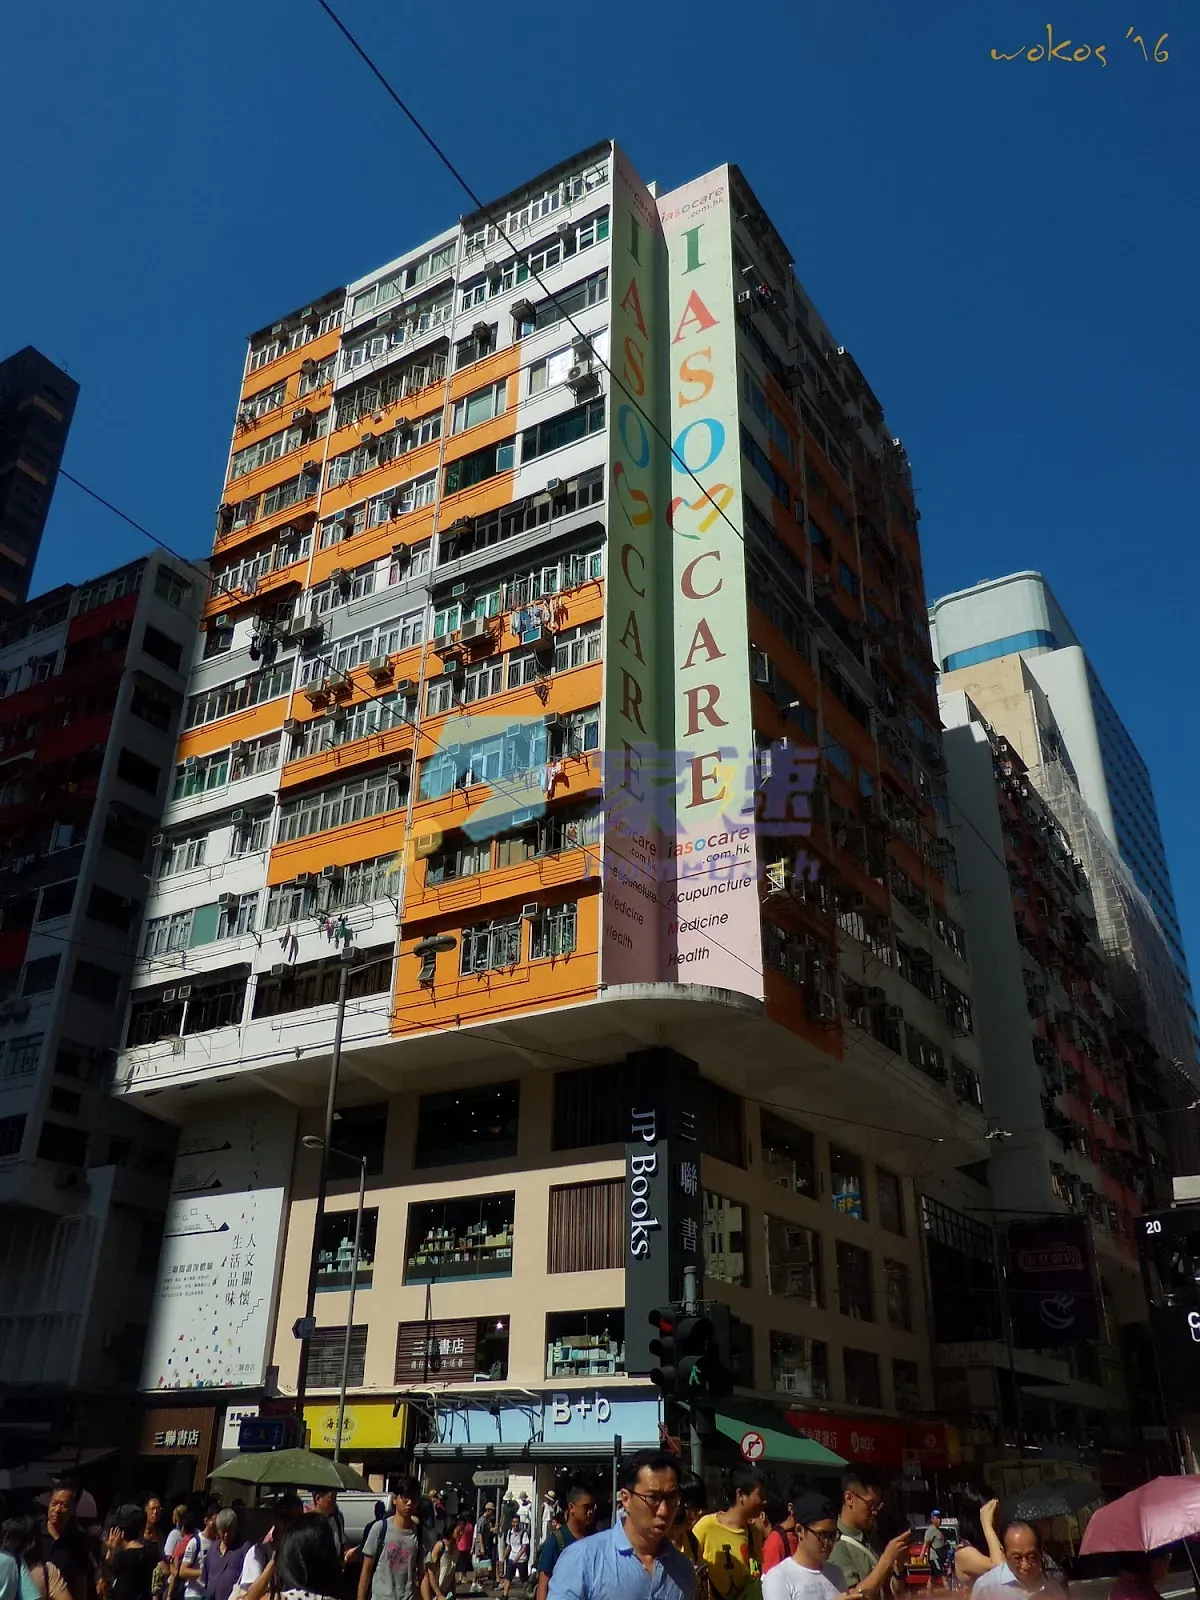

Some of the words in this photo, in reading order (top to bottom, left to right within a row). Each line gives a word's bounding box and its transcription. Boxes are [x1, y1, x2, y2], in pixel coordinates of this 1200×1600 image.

[661, 184, 725, 223] iasocare
[667, 826, 750, 859] iasocare
[702, 845, 750, 865] .com.hk
[666, 875, 752, 906] Acupuncture
[667, 912, 729, 936] Medicine
[667, 947, 710, 967] Health
[631, 1107, 656, 1143] JP
[630, 1151, 661, 1257] Books
[1145, 1220, 1162, 1234] 20
[224, 1234, 243, 1307] 生活品味
[551, 1391, 612, 1425] B+b
[152, 1429, 201, 1447] 三聯書店
